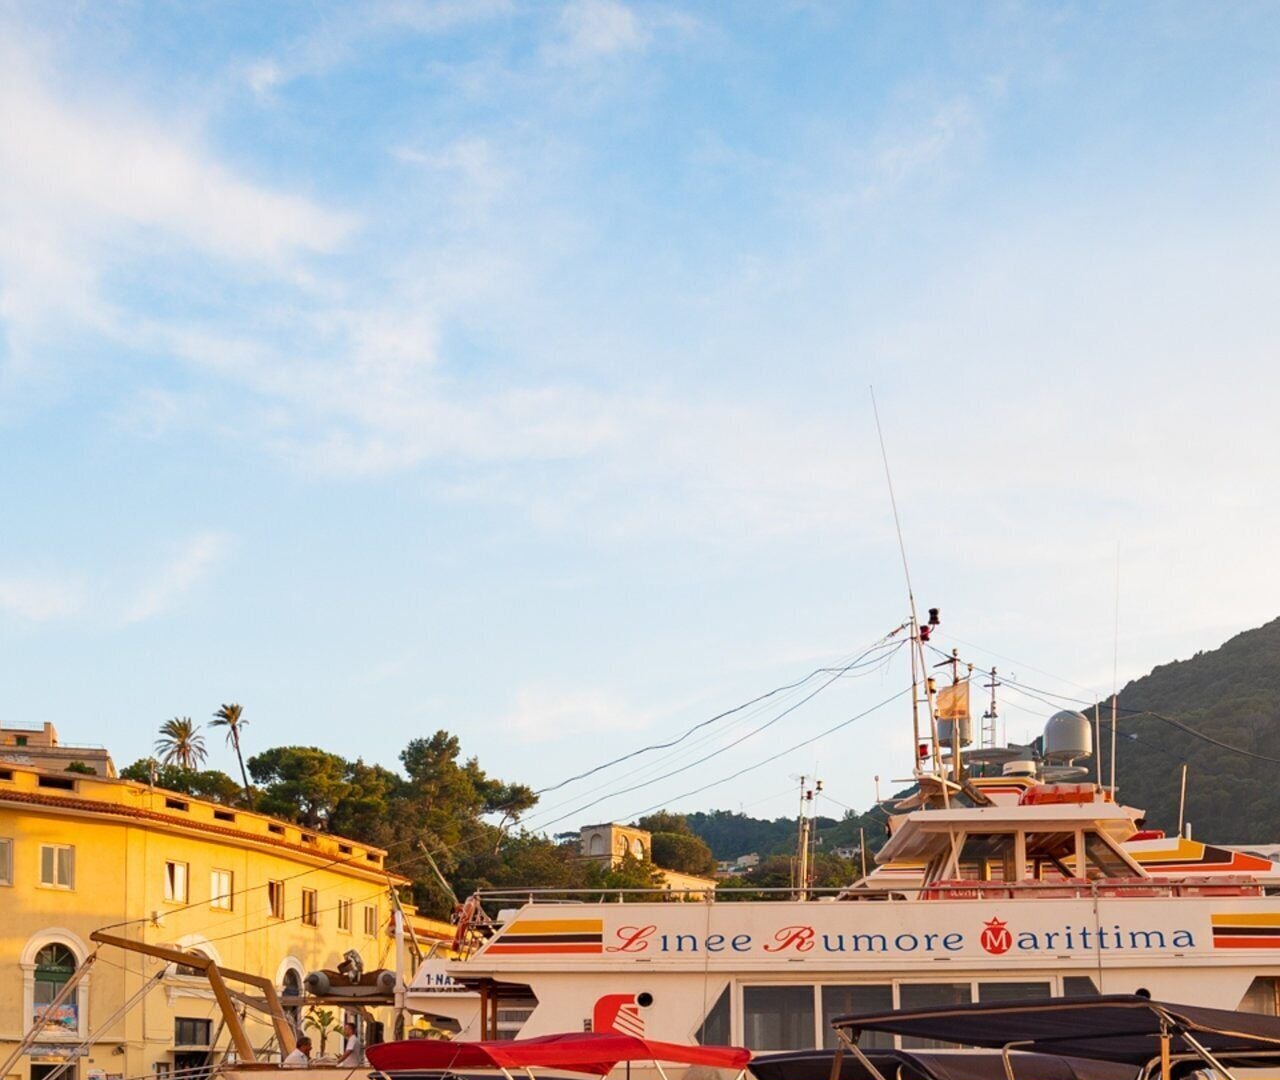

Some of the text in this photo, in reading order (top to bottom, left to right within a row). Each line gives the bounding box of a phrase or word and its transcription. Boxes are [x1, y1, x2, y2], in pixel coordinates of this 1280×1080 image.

[605, 921, 1196, 953] Linee Rumore Marittima
